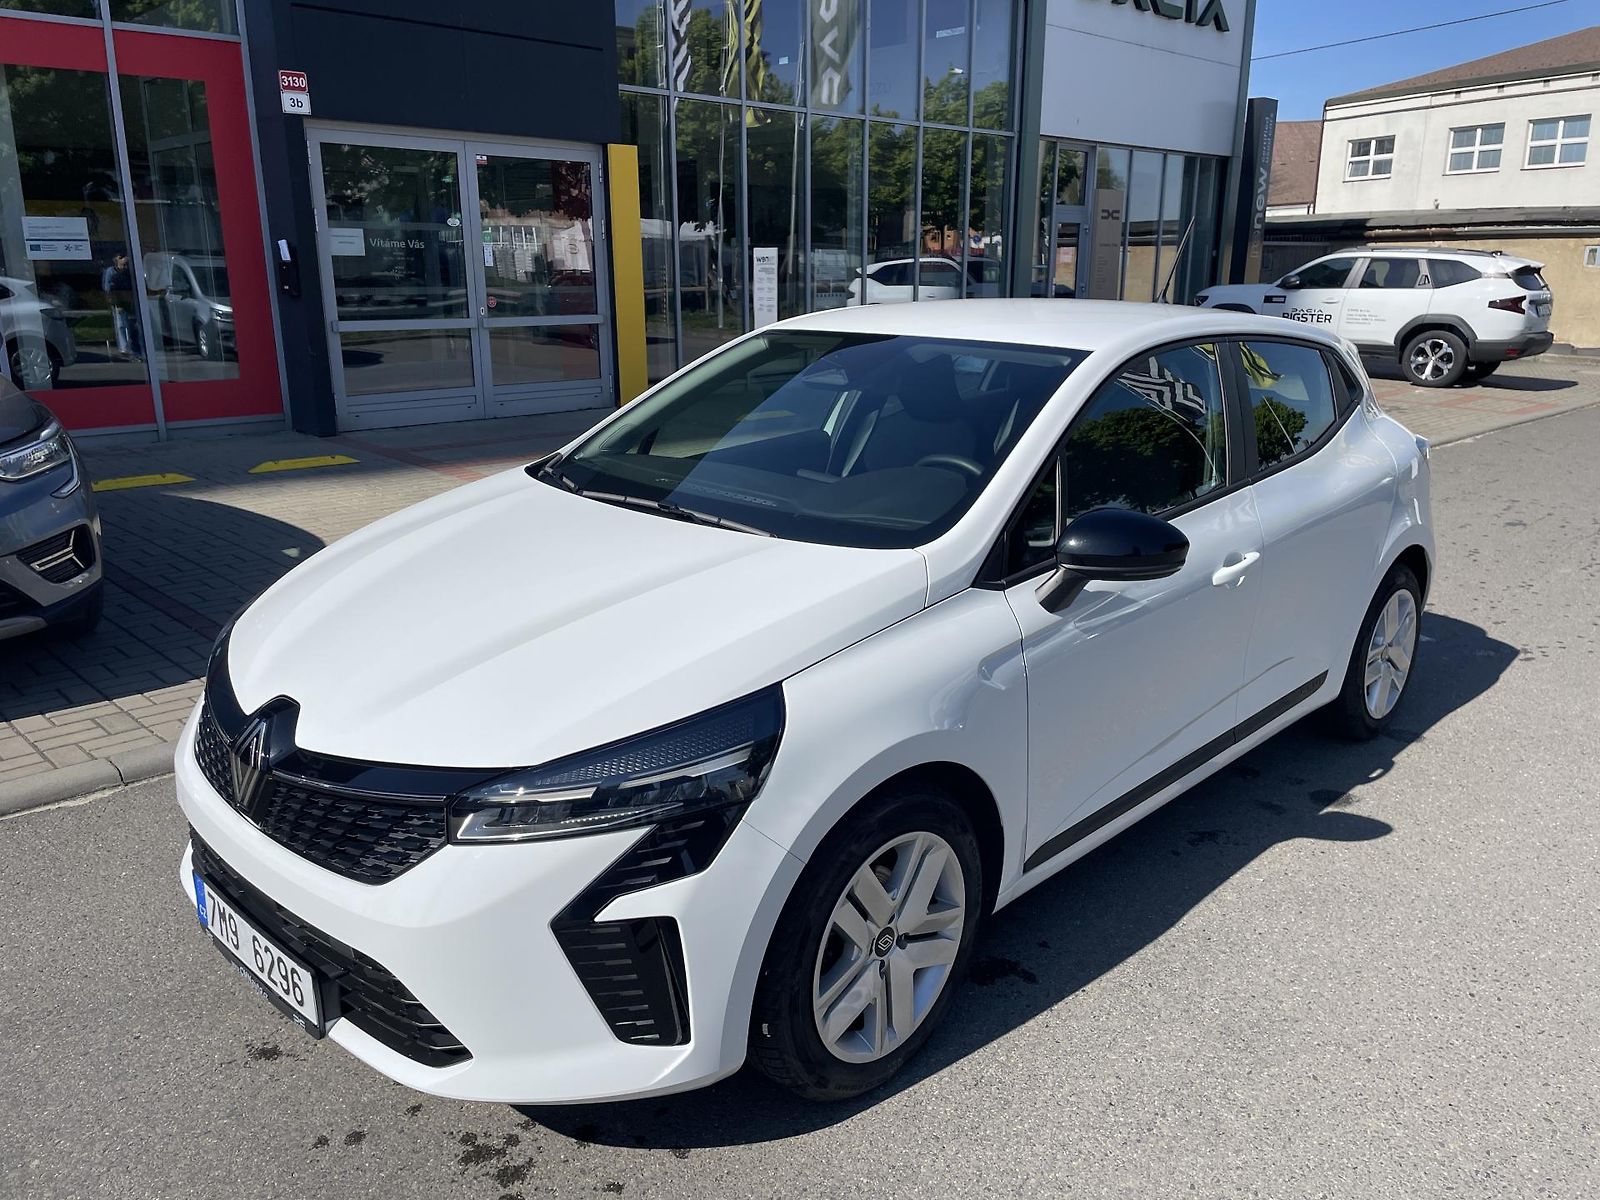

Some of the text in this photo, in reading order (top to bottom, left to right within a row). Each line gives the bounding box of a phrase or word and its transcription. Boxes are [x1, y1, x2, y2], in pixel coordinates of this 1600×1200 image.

[1083, 0, 1230, 32] CIA
[281, 75, 306, 88] 3130
[289, 97, 304, 108] 3b
[369, 238, 406, 248] Vítáme
[407, 239, 425, 249] Vás
[207, 891, 240, 951] 7M9
[252, 935, 304, 1007] 6296
